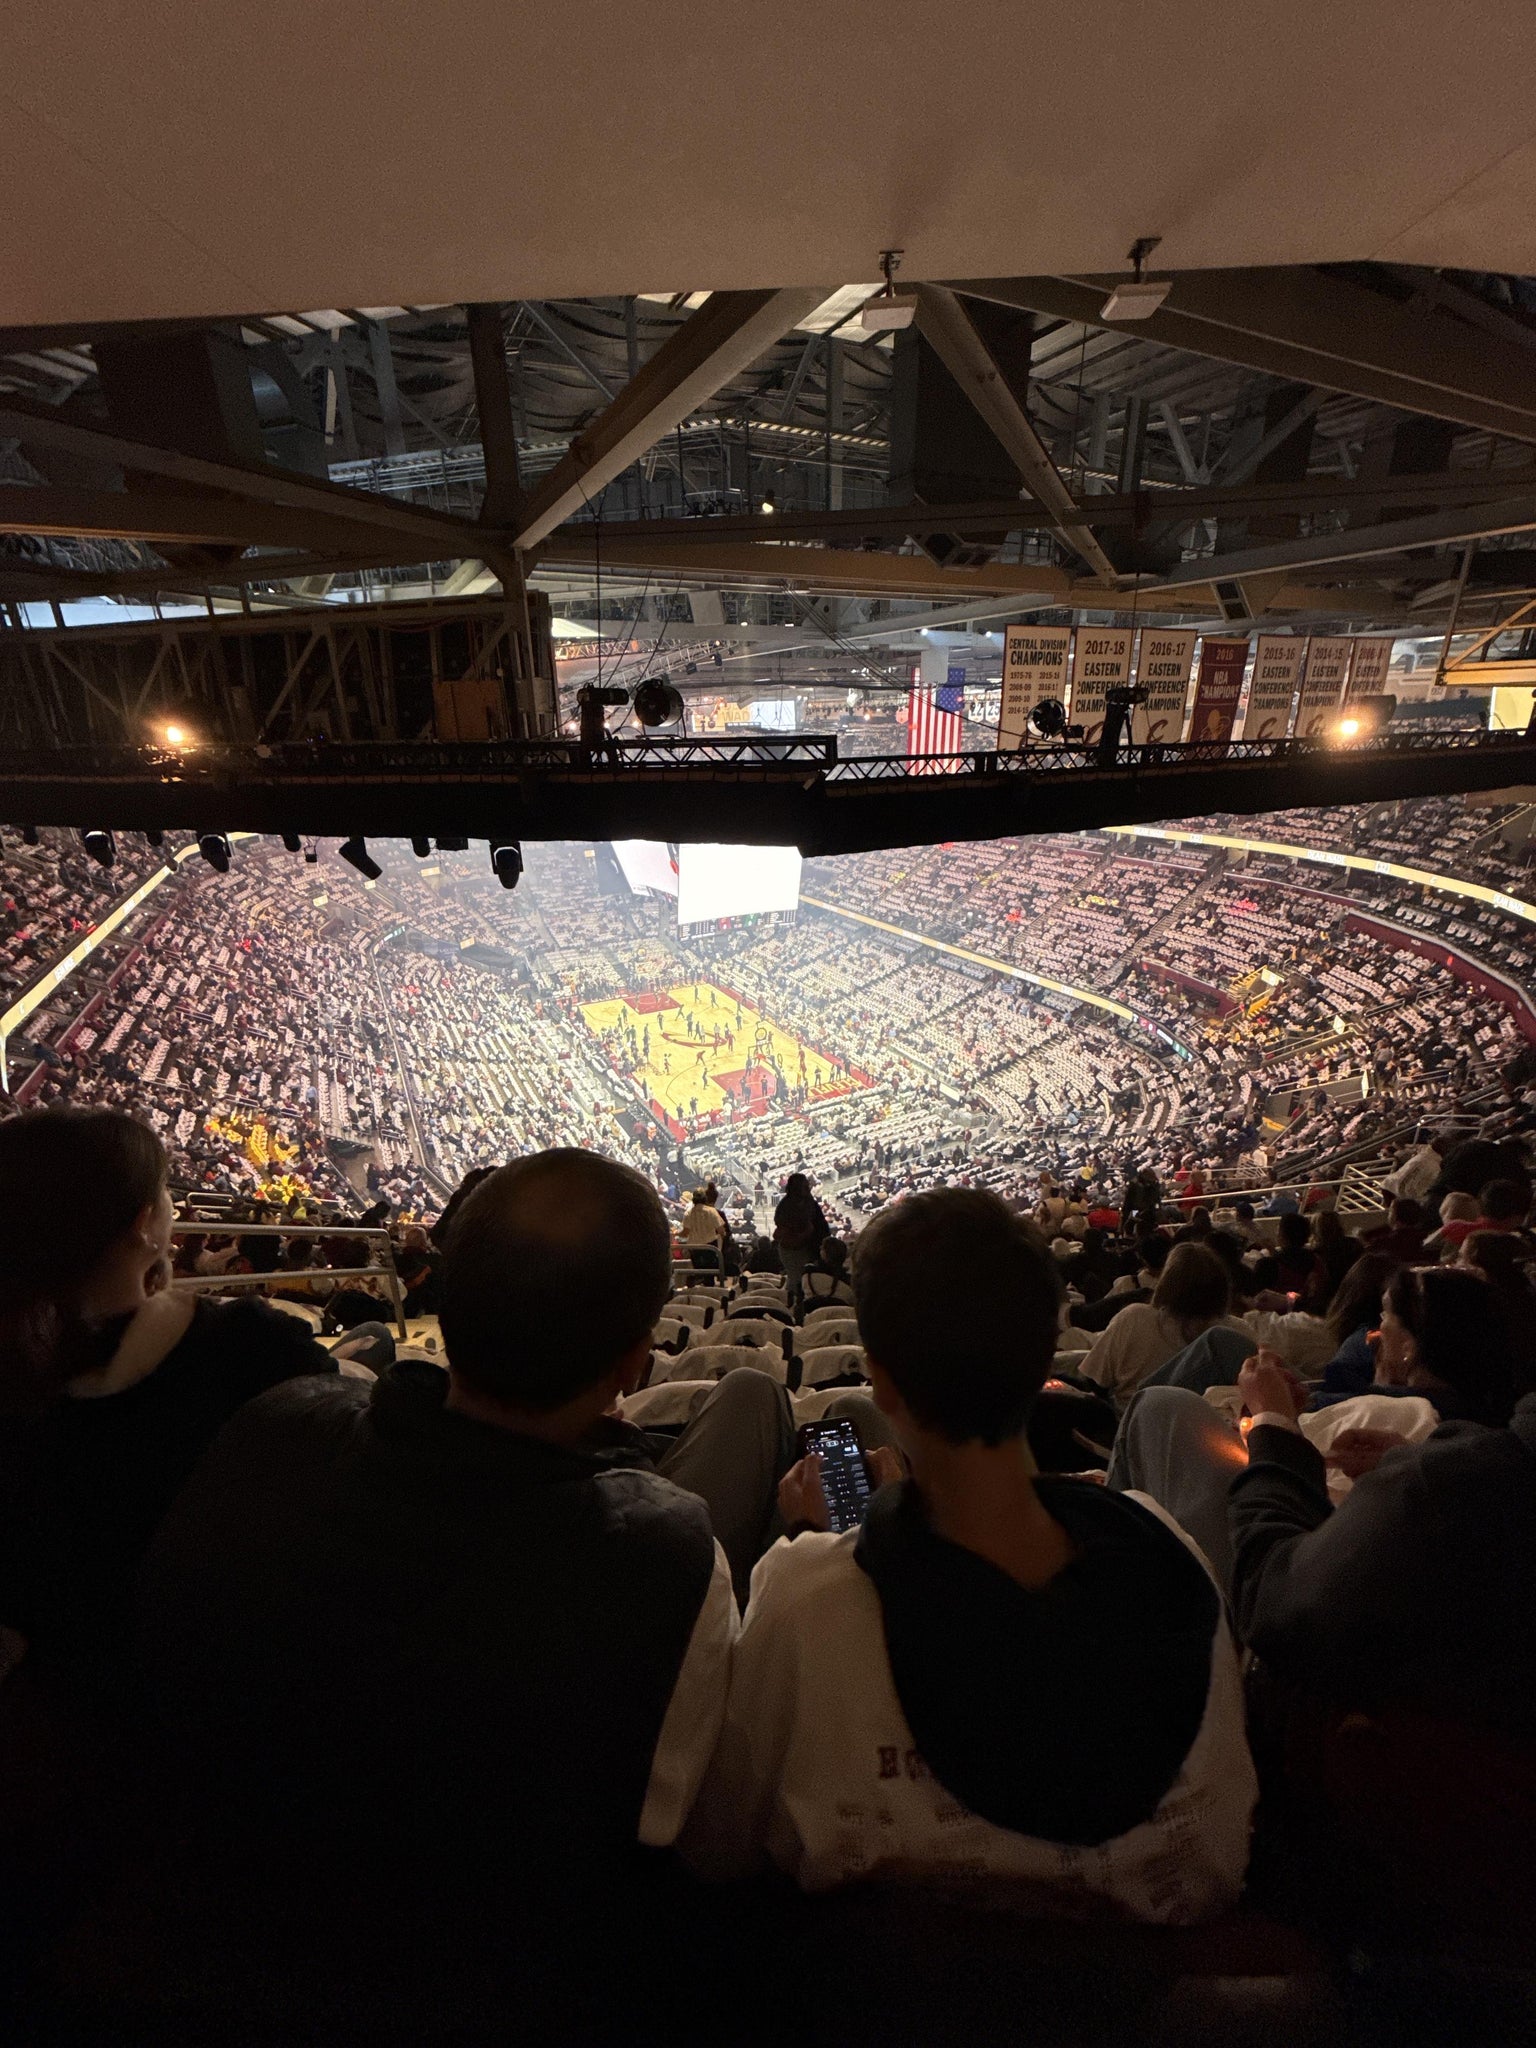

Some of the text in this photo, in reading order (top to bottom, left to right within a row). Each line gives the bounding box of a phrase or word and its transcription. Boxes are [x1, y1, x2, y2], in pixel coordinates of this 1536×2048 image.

[1009, 638, 1067, 650] CENTRAL DIVISION
[1085, 640, 1125, 655] 2017-18
[1150, 642, 1186, 655] 2016-17
[1010, 651, 1063, 666] CHAMPIONS
[1216, 649, 1234, 660] 2016
[1264, 648, 1296, 660] 2015-16
[1085, 662, 1121, 675] EASTERN
[1148, 663, 1182, 675] EASTERN
[1262, 666, 1291, 678] EASTERN
[1214, 671, 1229, 684] NBA
[1076, 699, 1106, 713] CHAMPI
